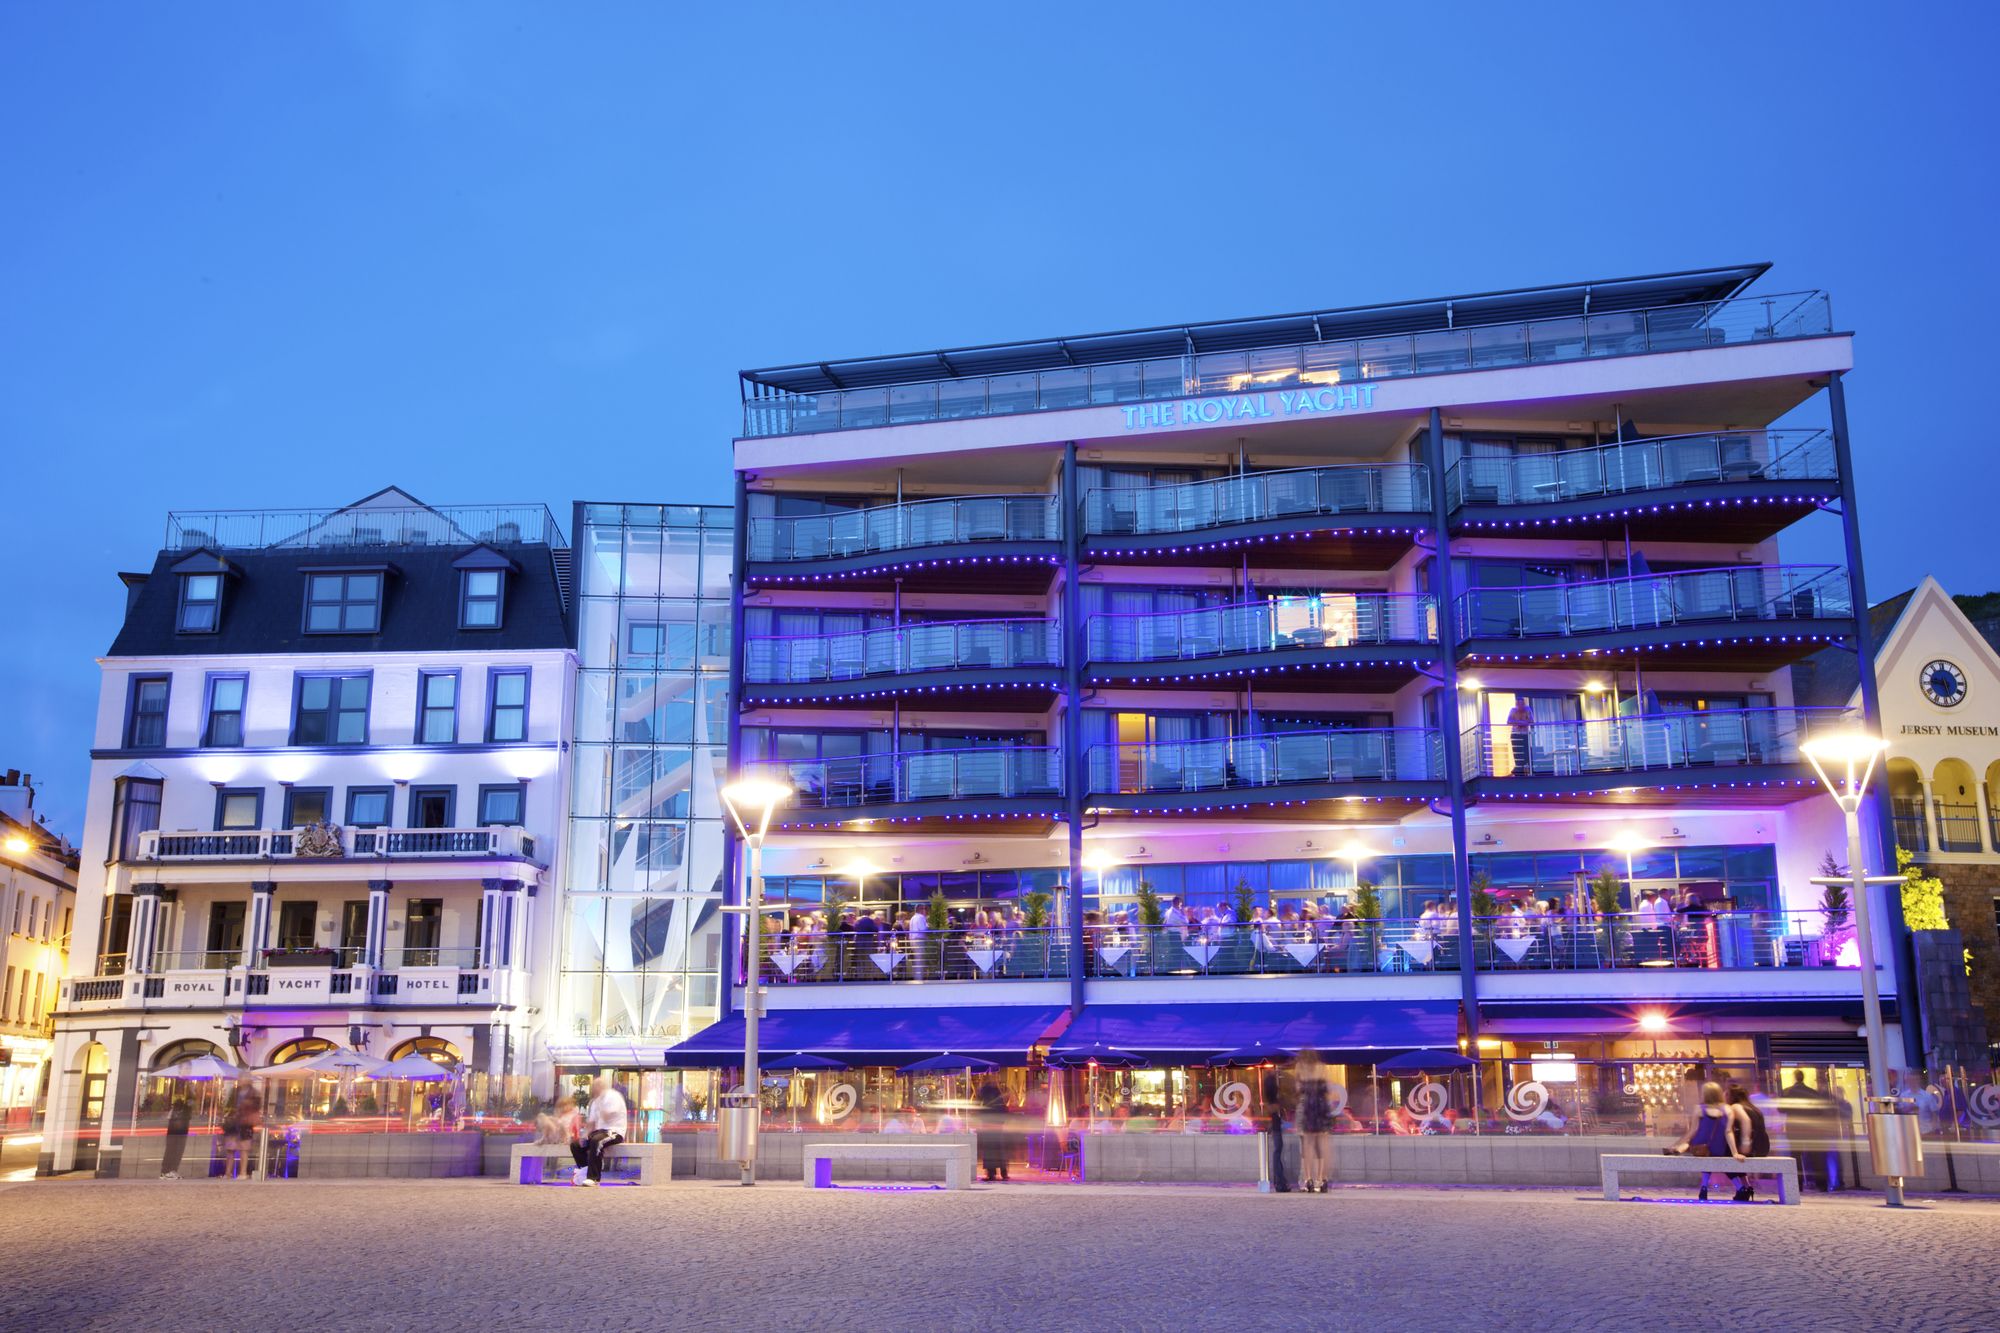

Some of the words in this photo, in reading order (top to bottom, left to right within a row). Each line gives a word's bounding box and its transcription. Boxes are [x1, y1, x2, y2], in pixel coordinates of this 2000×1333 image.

[1120, 404, 1176, 430] THE
[1182, 395, 1273, 425] ROYAL
[1279, 383, 1379, 415] YACHT
[1900, 725, 1943, 735] JERSEY
[1947, 726, 1999, 737] MUSEUM
[174, 983, 215, 992] ROYAL
[279, 980, 321, 989] YACHT
[406, 980, 449, 989] HOTEL
